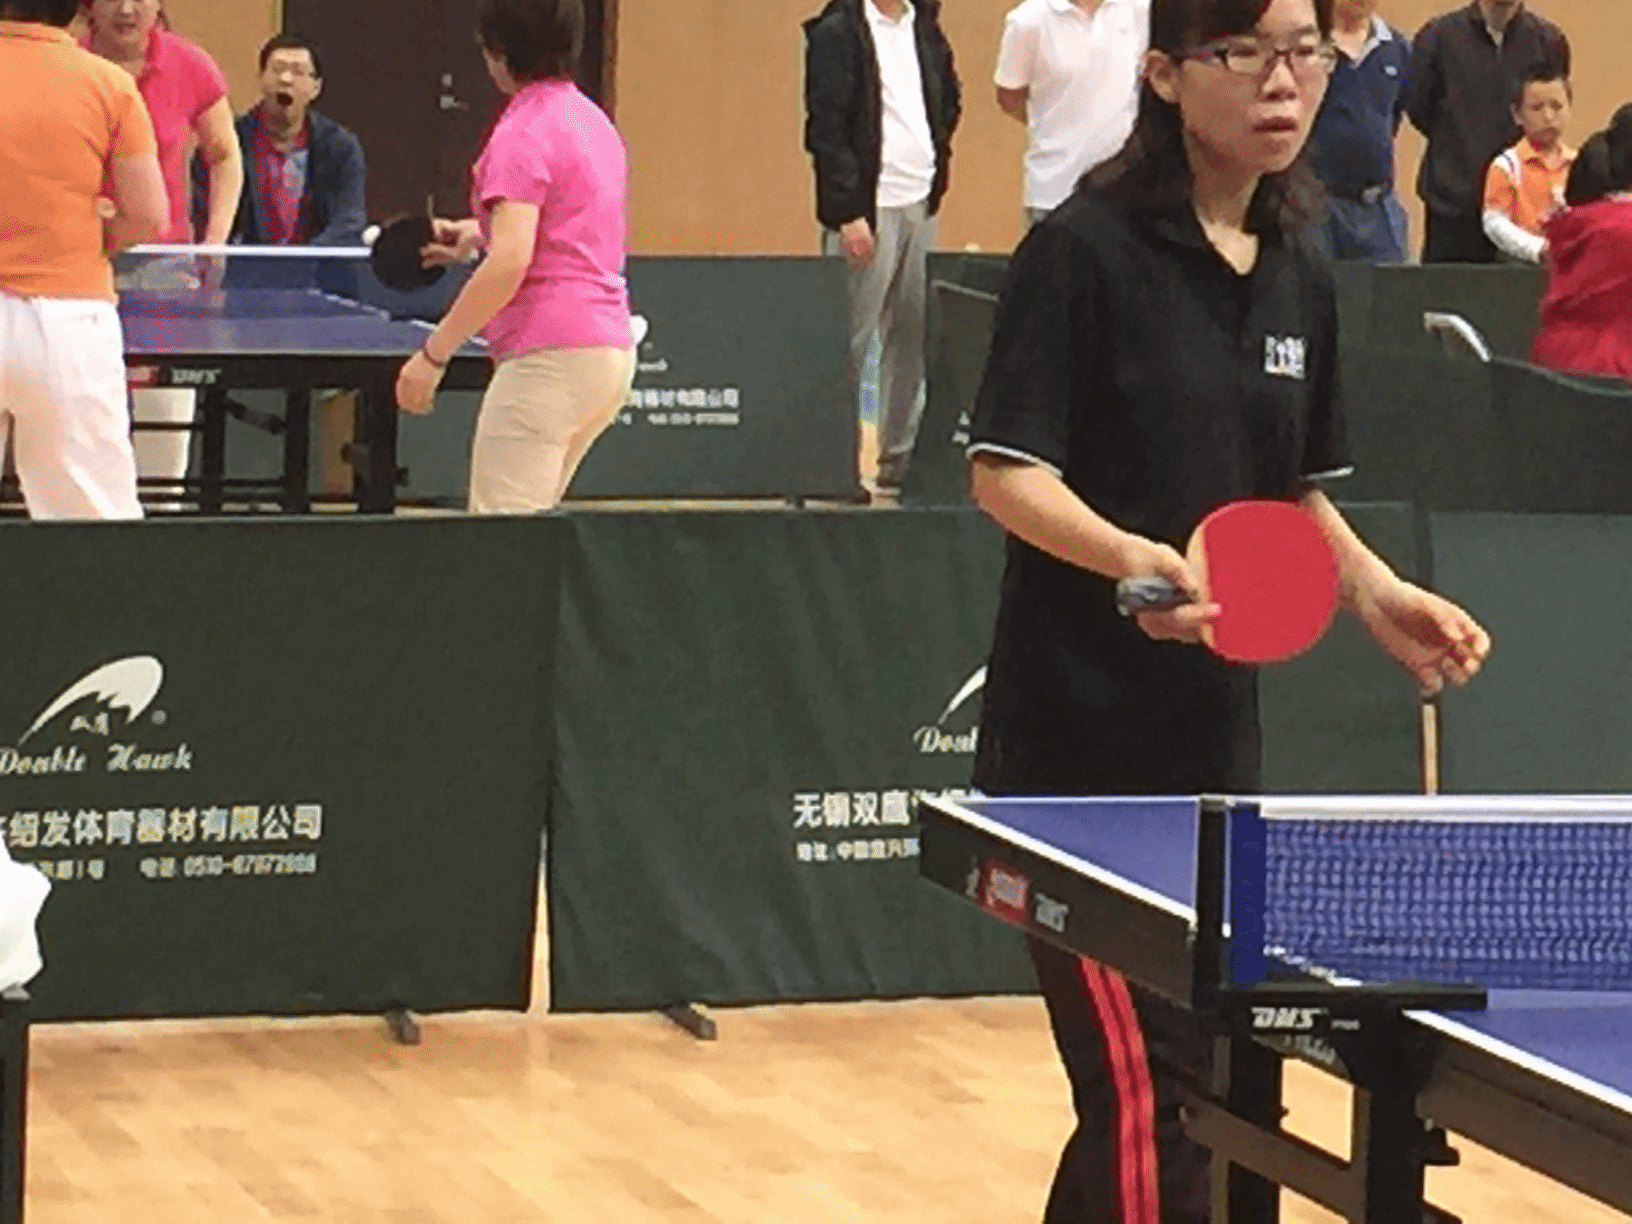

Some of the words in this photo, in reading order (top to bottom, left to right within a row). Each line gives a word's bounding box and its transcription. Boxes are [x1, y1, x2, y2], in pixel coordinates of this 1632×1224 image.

[106, 742, 193, 772] Hawk
[0, 804, 322, 848] 绍发体育器材有限公司
[793, 789, 922, 829] 无锡双鹰
